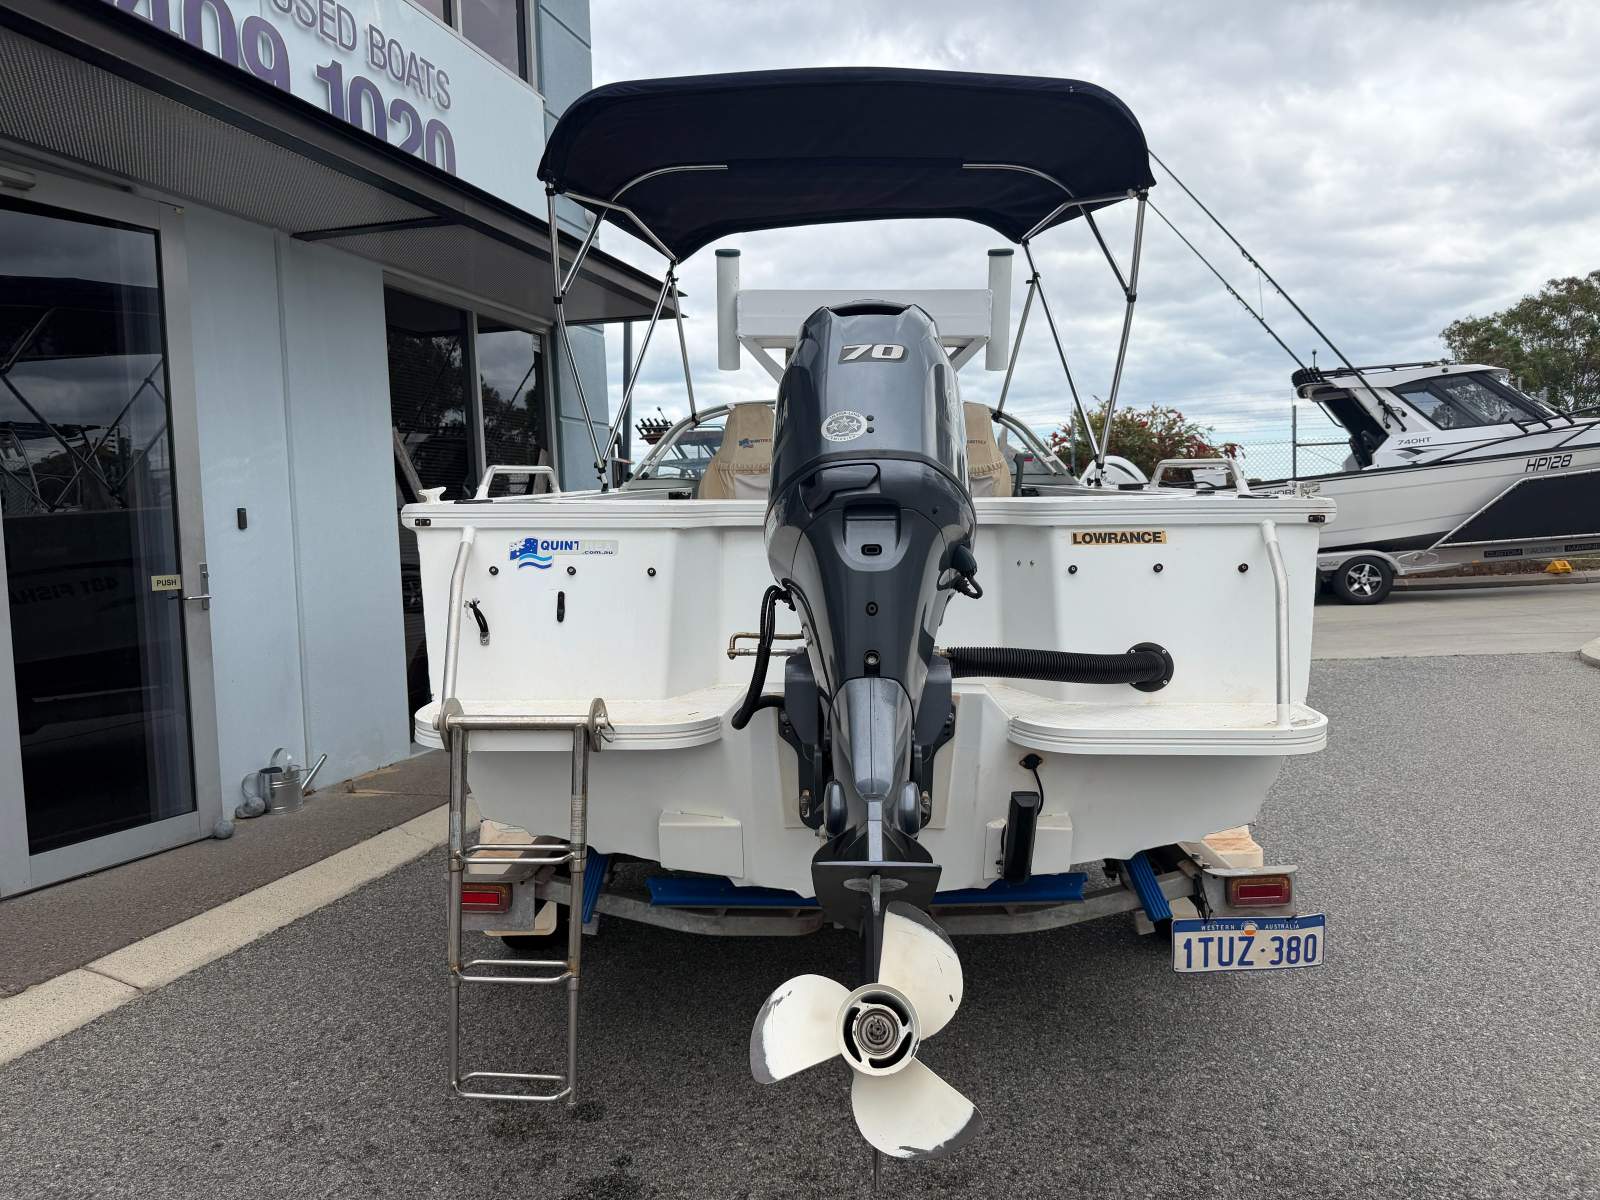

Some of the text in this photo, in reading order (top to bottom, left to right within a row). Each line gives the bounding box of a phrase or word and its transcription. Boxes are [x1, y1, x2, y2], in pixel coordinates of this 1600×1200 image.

[368, 23, 451, 110] BOATS
[316, 59, 457, 177] 1020
[842, 344, 905, 361] 70
[1397, 436, 1432, 445] 740HT
[1525, 454, 1573, 472] HP128
[1072, 531, 1163, 545] LOWRANCE
[156, 579, 177, 587] PUSH
[1264, 922, 1300, 930] AUSTRALIA
